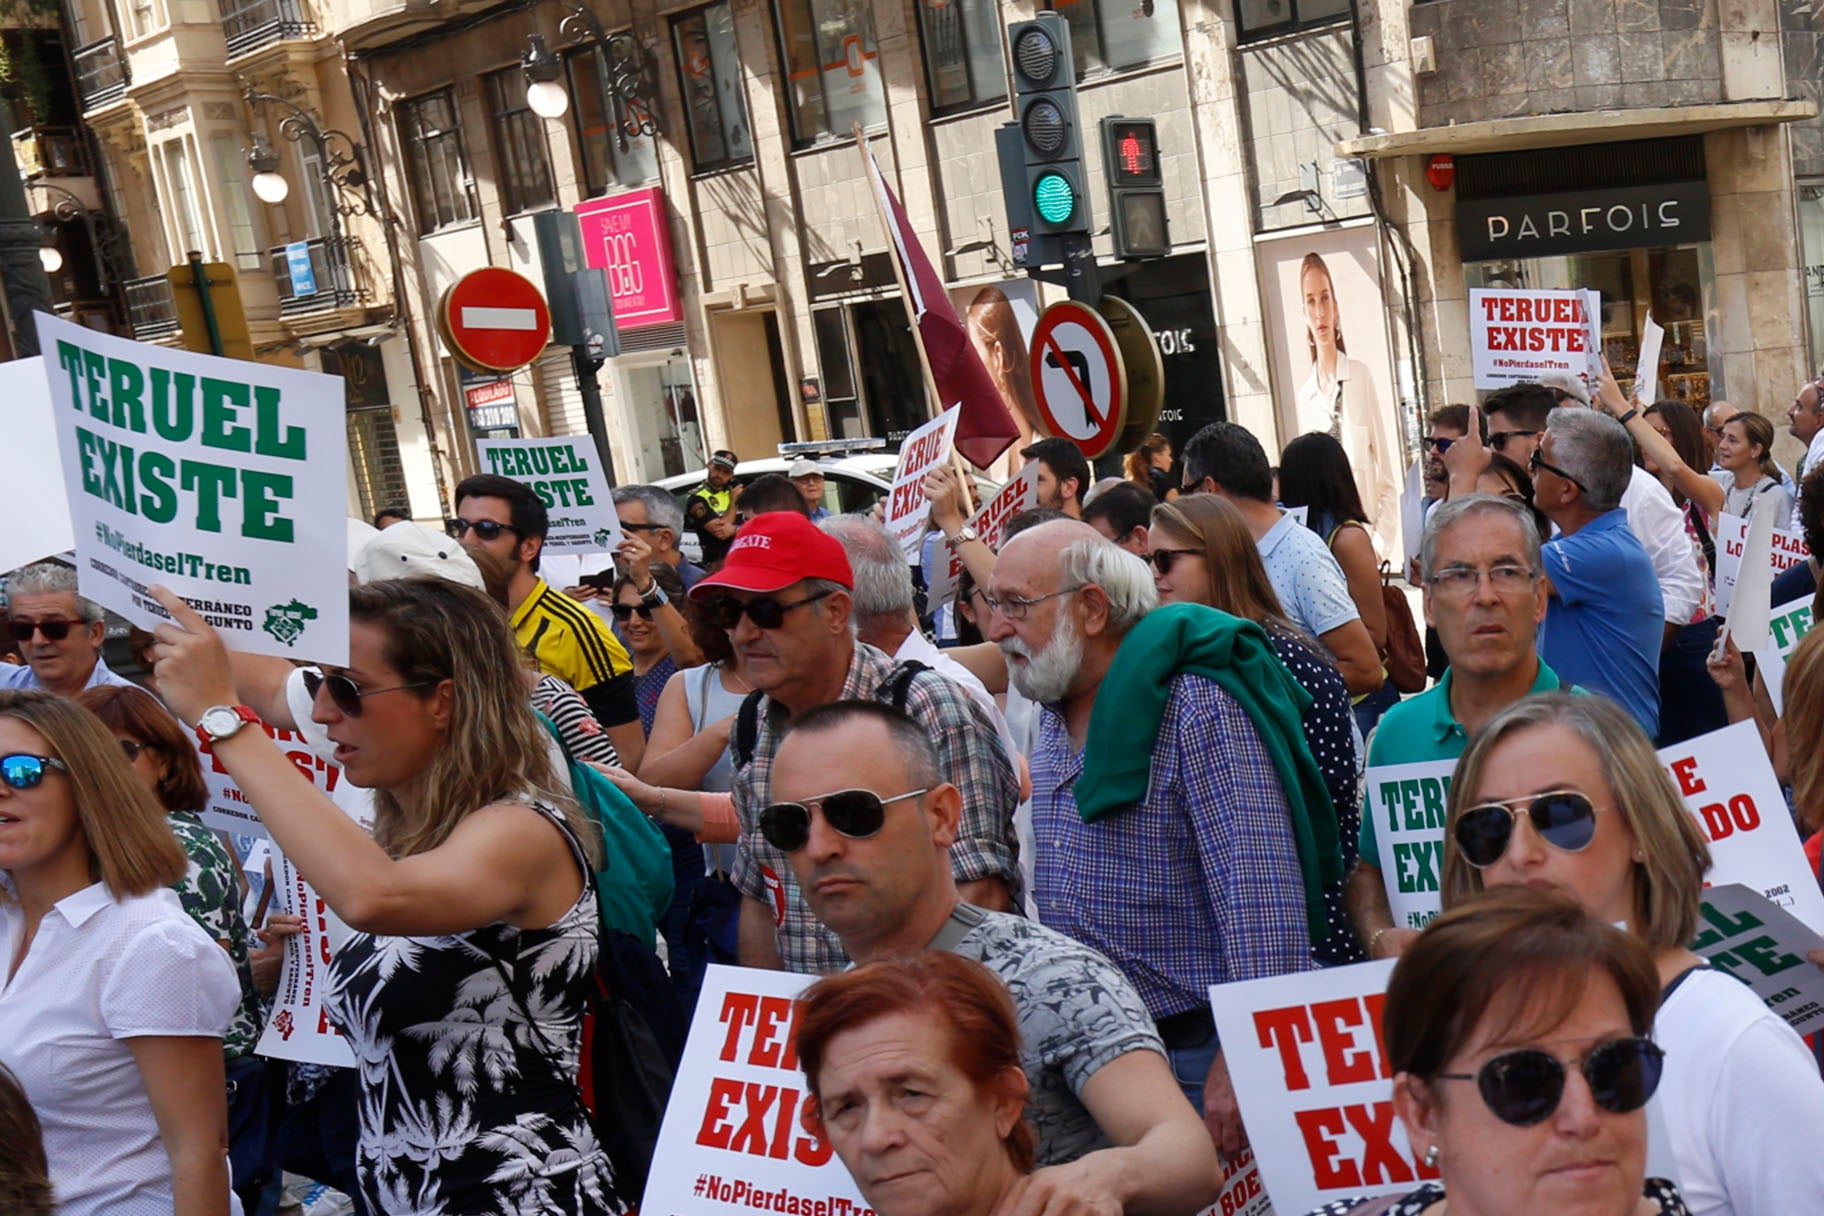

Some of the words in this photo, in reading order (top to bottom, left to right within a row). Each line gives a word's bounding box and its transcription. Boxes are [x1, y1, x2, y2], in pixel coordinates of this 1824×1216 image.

[1488, 201, 1680, 242] PARFOIS
[1487, 327, 1583, 352] EXISTE
[1493, 360, 1569, 368] #NoPierdaselTren
[56, 339, 306, 460] TERUEL
[76, 426, 294, 542] EXISTE
[486, 445, 588, 476] TERUEL
[528, 479, 594, 509] STE
[891, 472, 930, 522] EXIS
[971, 476, 1028, 536] RUEL
[96, 520, 251, 584] #NoPierdaselTren
[1380, 776, 1452, 832] TER
[1392, 840, 1444, 893] EXI
[1765, 884, 1790, 898] 2002
[296, 868, 314, 1007] NoPierdaselTren
[695, 1076, 836, 1167] EXIS
